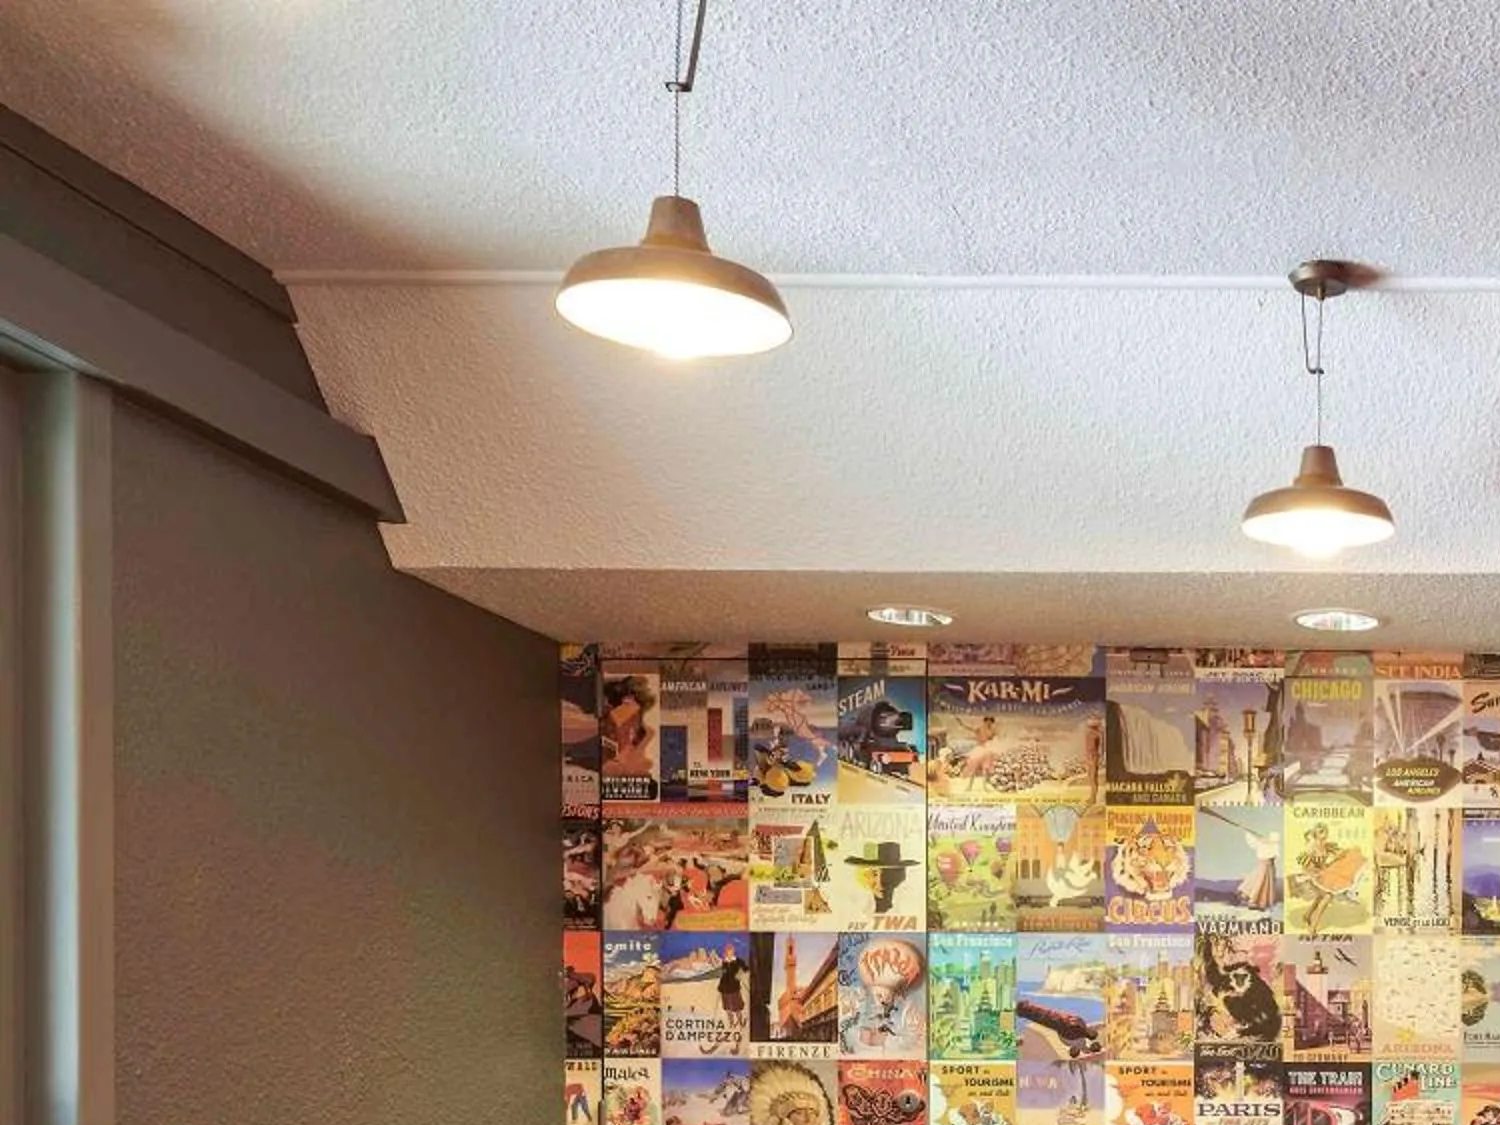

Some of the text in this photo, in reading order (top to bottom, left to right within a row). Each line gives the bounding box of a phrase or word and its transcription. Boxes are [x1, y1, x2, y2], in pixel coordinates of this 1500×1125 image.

[1415, 666, 1462, 679] INDIA
[967, 680, 1049, 704] KAR-MI
[1291, 680, 1362, 700] CHICAGO
[839, 679, 886, 716] STEAM
[791, 793, 832, 806] ITALY
[1293, 806, 1367, 818] CARIBBEAN
[840, 812, 923, 839] ARIZONA
[1108, 896, 1191, 924] CIRCUS
[872, 914, 918, 931] TWA
[665, 1019, 725, 1031] CORTINA
[665, 1032, 742, 1044] D'AMPEZZO
[757, 1045, 832, 1058] FIRENZE
[1382, 1042, 1454, 1054] ARIZONA
[847, 1065, 915, 1080] CHINA
[941, 1065, 980, 1075] SPORT
[1118, 1065, 1158, 1075] SPORT
[1375, 1063, 1455, 1084] CUNARD
[964, 1077, 1015, 1087] TOURISME
[1140, 1078, 1192, 1088] TOURISME
[1419, 1074, 1458, 1091] LINE
[1198, 1102, 1282, 1118] PARIS
